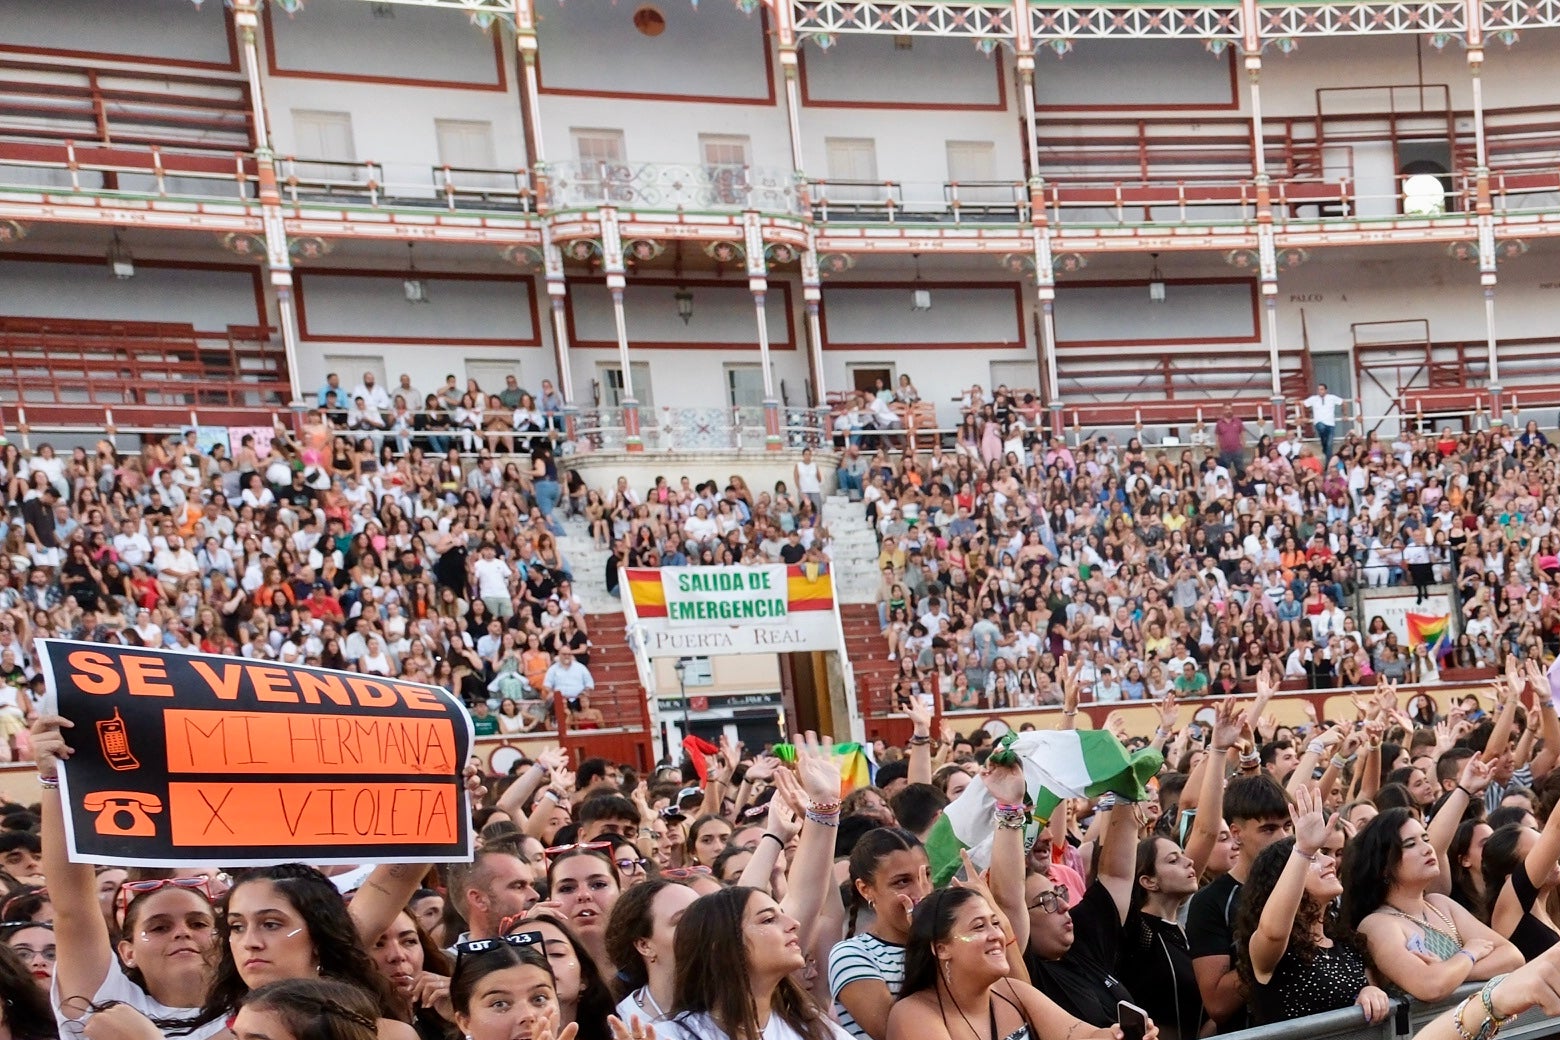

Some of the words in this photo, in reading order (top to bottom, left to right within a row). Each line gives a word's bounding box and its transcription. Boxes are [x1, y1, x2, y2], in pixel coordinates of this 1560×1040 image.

[679, 573, 744, 592] SALIDA
[750, 572, 771, 590] DE
[669, 599, 786, 620] EMERGENCIA
[656, 631, 733, 649] PUERTA
[754, 628, 807, 645] REAL
[67, 650, 175, 697] SE
[187, 660, 448, 712] VENDE
[184, 715, 268, 767] MI
[288, 716, 453, 770] HERMANA
[197, 788, 234, 835] X
[279, 788, 452, 837] VIOLETA
[469, 940, 492, 951] OT
